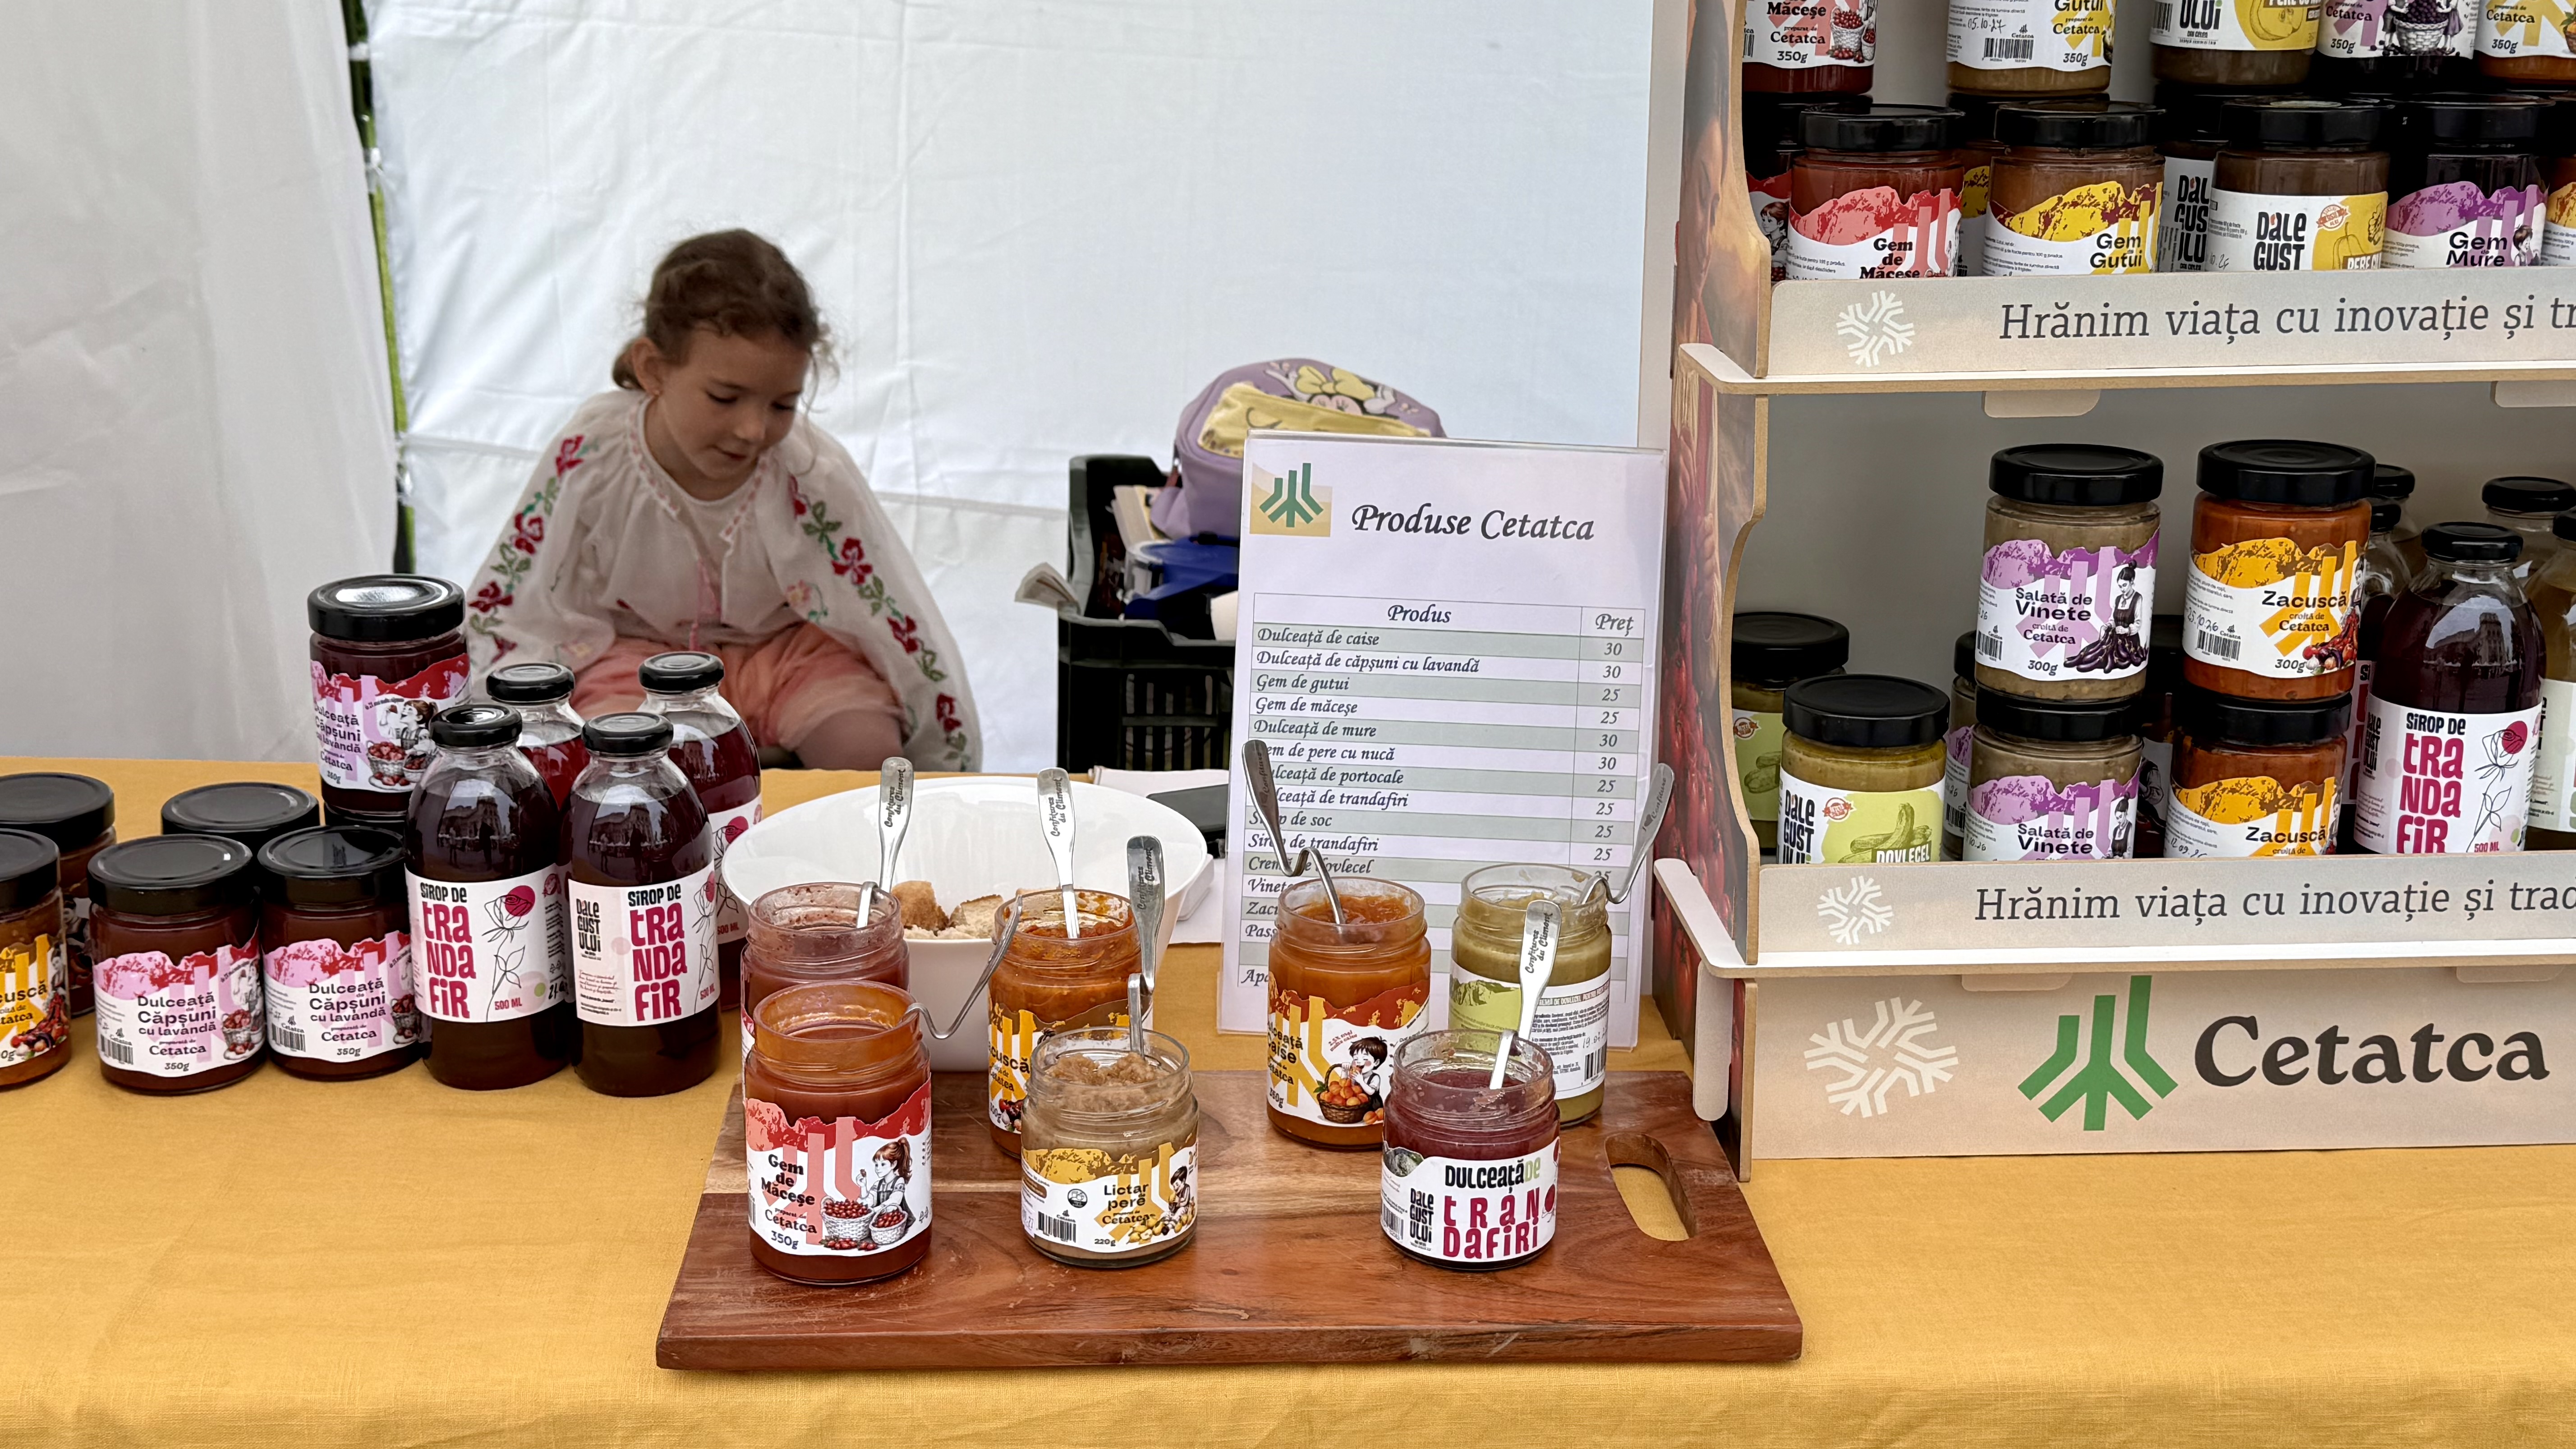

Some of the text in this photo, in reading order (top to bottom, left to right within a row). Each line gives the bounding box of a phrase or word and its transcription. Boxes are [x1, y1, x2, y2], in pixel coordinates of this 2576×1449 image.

[2326, 6, 2373, 22] Cetatca
[2486, 10, 2535, 23] Cetatca
[2053, 23, 2100, 34] Cetatca
[1771, 32, 1825, 44] Cetatca
[2331, 39, 2356, 54] 350g
[2492, 39, 2518, 55] 350g
[1777, 51, 1808, 63] 350g
[2063, 53, 2088, 66] 350g
[1874, 238, 1913, 251] Gem
[2097, 233, 2141, 250] Gem
[2450, 232, 2507, 250] Gem
[1882, 253, 1903, 265] de
[2090, 250, 2142, 269] Gutui
[2254, 242, 2305, 271] GUST
[2446, 250, 2505, 267] Mure
[1999, 302, 2149, 339] Hrănim
[2165, 300, 2260, 345] viața
[2276, 307, 2320, 333] cu
[2334, 297, 2489, 340] inovație
[2503, 294, 2535, 339] și
[1352, 503, 1595, 540] Produse Cetatca
[2016, 587, 2093, 605] Salată de
[2262, 590, 2347, 608] Zacuscă
[1387, 604, 1452, 623] Produs
[2015, 600, 2091, 621] Vinete
[2279, 620, 2329, 631] Cetatca
[1257, 627, 1623, 656] Dulceață de caise 30
[2024, 629, 2076, 644] Cetatca
[1256, 650, 1322, 670] Dulceață
[1325, 652, 1341, 667] de
[1402, 659, 1419, 670] cu
[1422, 657, 1481, 673] lavandă
[1603, 665, 1621, 679] 30
[2028, 659, 2058, 676] 300g
[2275, 659, 2307, 673] 300g
[1256, 674, 1620, 702] Gem de gutui 25
[1255, 697, 1286, 714] Gem
[1290, 697, 1306, 712] de
[1600, 711, 1619, 725] 25
[1254, 719, 1618, 747] Dulceață de mure 30
[1288, 742, 1617, 770] de pere cu nucă 30
[1320, 767, 1616, 793] de portocale 25
[1319, 789, 1615, 815] de trandafiri 25
[1290, 810, 1307, 826] de
[1310, 816, 1332, 827] soc
[1595, 824, 1614, 838] 25
[2018, 823, 2094, 839] Salată de
[1784, 817, 1815, 854] GUST
[2245, 825, 2326, 843] Zacuscă
[1290, 833, 1613, 861] de trandafiri 25
[2018, 835, 2093, 854] Vinete
[1974, 886, 2120, 920] Hrănim
[2135, 886, 2227, 926] viața
[2242, 892, 2285, 916] cu
[2299, 881, 2450, 922] inovație
[2464, 879, 2494, 921] și
[577, 915, 601, 934] GUST
[308, 977, 385, 995] Dulceață
[138, 991, 215, 1007] Dulceață
[309, 991, 386, 1013] Căpșuni
[494, 997, 523, 1011] 500 ML
[138, 1006, 216, 1028] Căpșuni
[310, 1007, 386, 1022] cu lavandă
[138, 1023, 216, 1036] cu lavandă
[321, 1030, 377, 1042] Cetatca
[148, 1044, 207, 1056] Cetatca
[2194, 1015, 2550, 1087] Cetatca
[164, 1062, 190, 1072] 350g
[768, 1154, 804, 1175] Gem
[775, 1172, 795, 1187] de
[1104, 1182, 1149, 1196] Lictar
[764, 1209, 817, 1235] Cetatca
[1410, 1204, 1435, 1227] GUST
[771, 1230, 800, 1250] 350g
[1094, 1238, 1116, 1247] 220g
